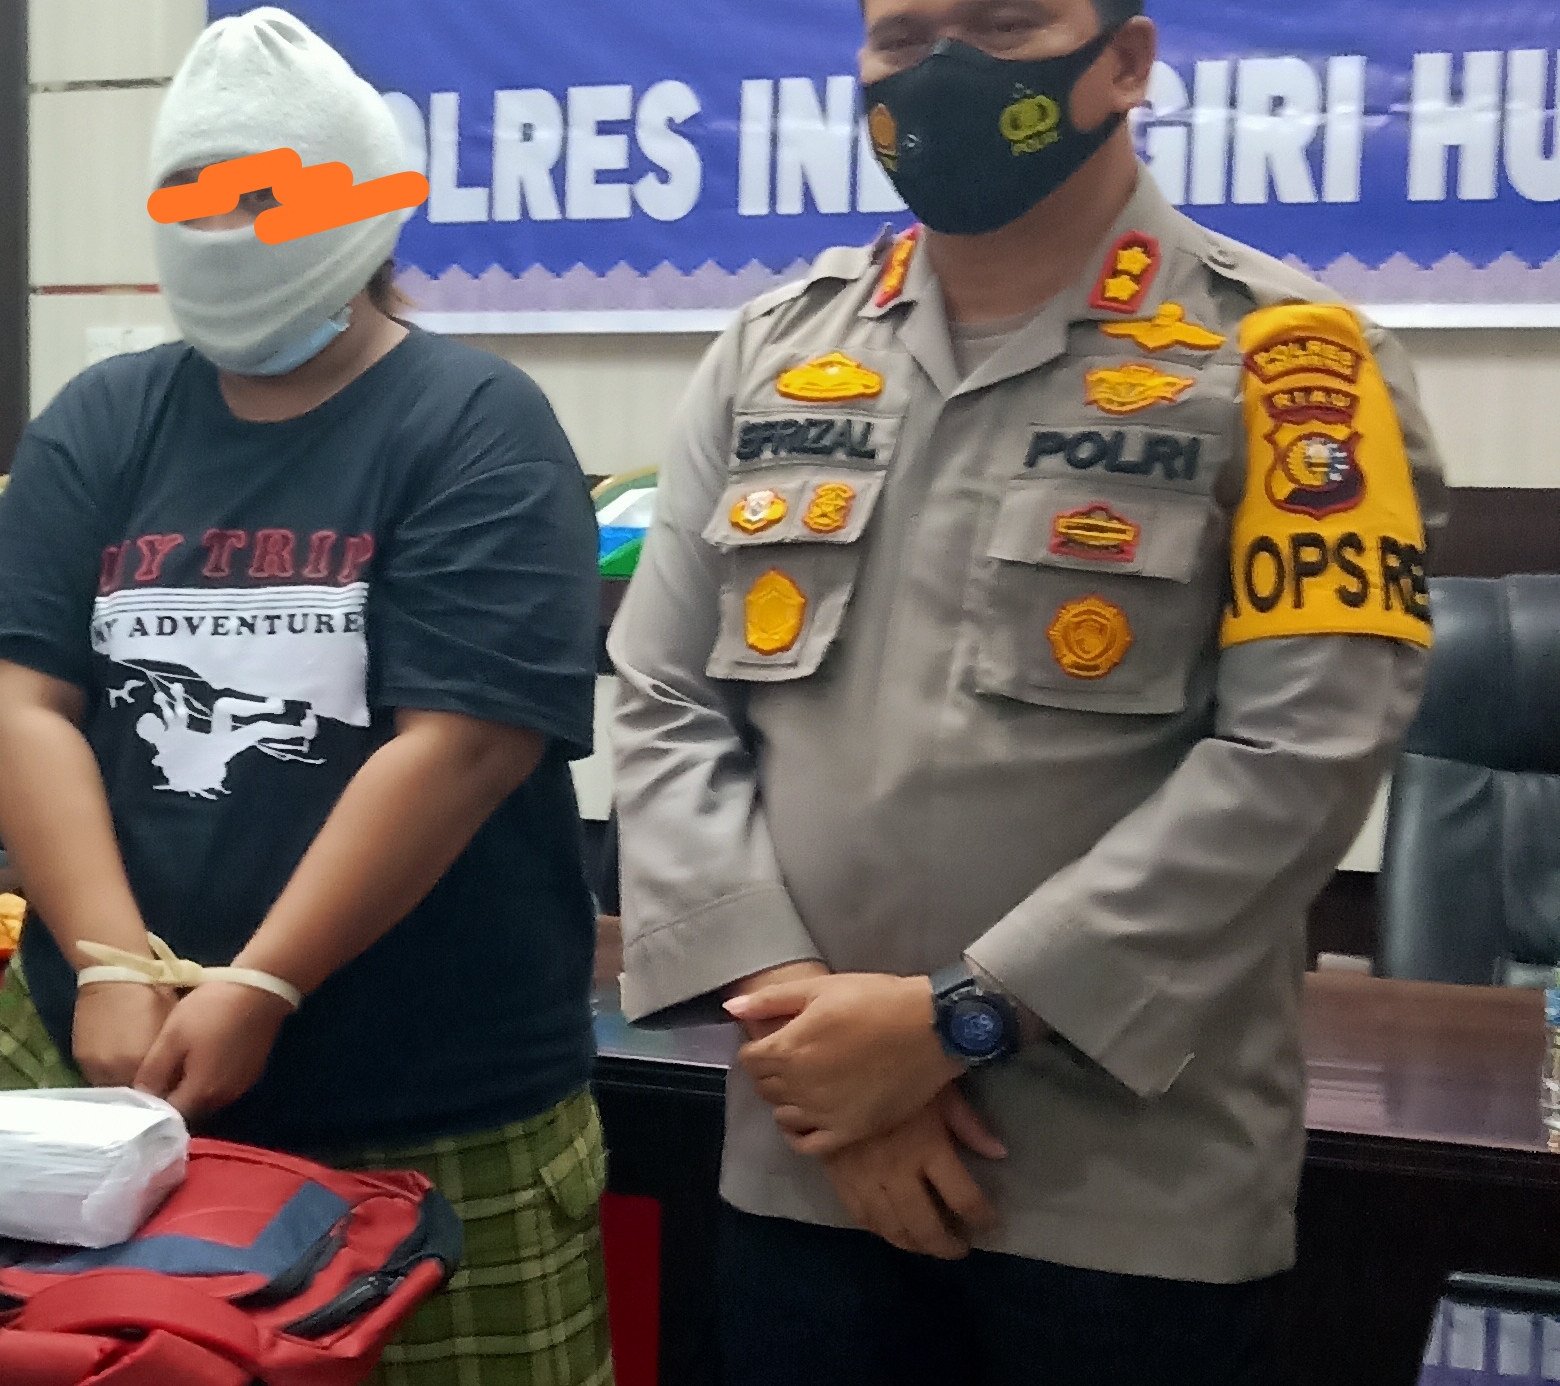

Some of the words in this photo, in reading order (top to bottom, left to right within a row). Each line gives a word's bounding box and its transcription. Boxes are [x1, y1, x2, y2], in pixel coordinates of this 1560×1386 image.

[1022, 430, 1203, 481] POLRI
[202, 528, 375, 584] TRIP
[128, 612, 365, 638] ADVENTURE
